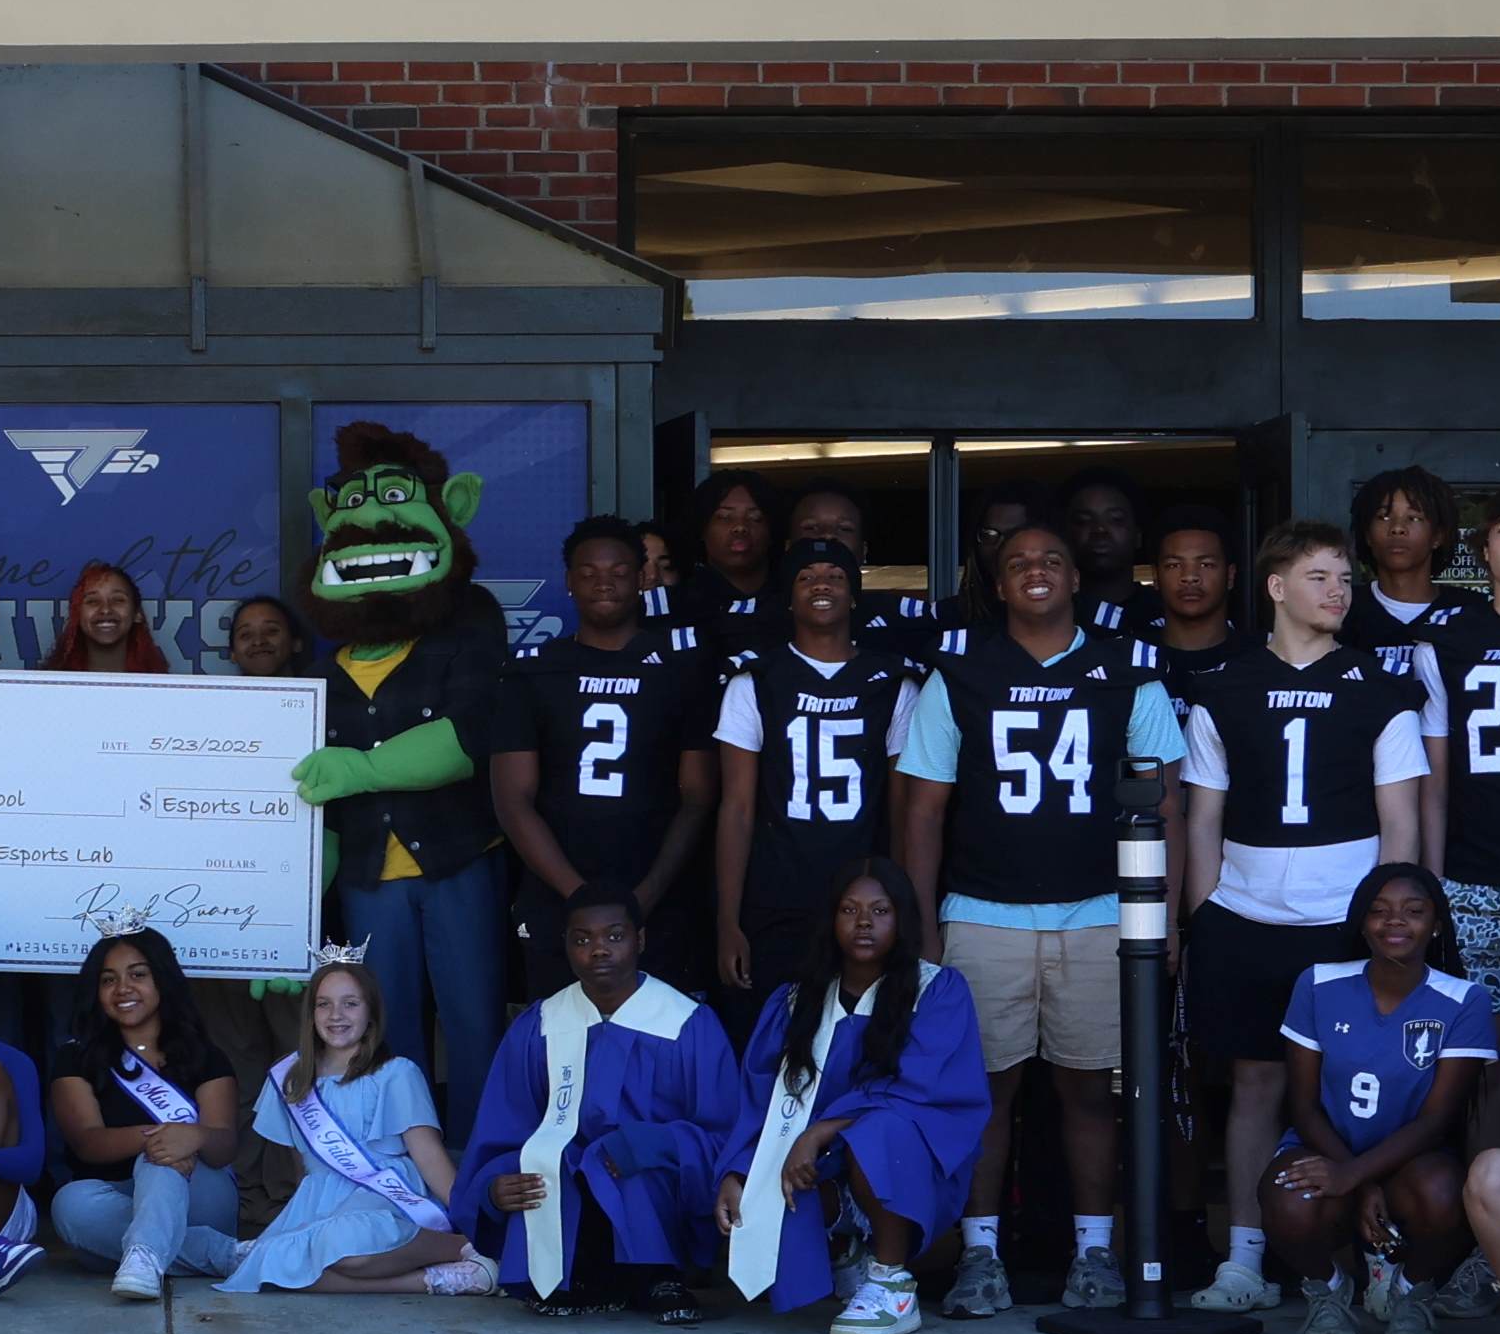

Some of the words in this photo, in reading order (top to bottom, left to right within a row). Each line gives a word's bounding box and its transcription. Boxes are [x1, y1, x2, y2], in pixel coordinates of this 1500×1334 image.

[163, 529, 268, 597] the
[1375, 645, 1415, 662] TRIT
[578, 675, 640, 695] TRITON
[1009, 685, 1074, 703] TRITON
[280, 698, 305, 709] 5673
[796, 692, 858, 713] TRITON
[1266, 689, 1333, 709] TRITON
[101, 741, 129, 751] DATE
[148, 737, 263, 754] 5/23/2025
[578, 702, 628, 797] 2
[785, 716, 865, 822] 15
[992, 708, 1093, 814] 54
[1281, 717, 1309, 824] 1
[162, 797, 241, 820] Esports
[249, 797, 290, 816] Lab
[76, 847, 113, 864] Lab
[205, 858, 257, 869] DOLLARS
[1409, 1021, 1441, 1030] TRITON
[1349, 1071, 1381, 1119] 9
[317, 1130, 358, 1171] Triton
